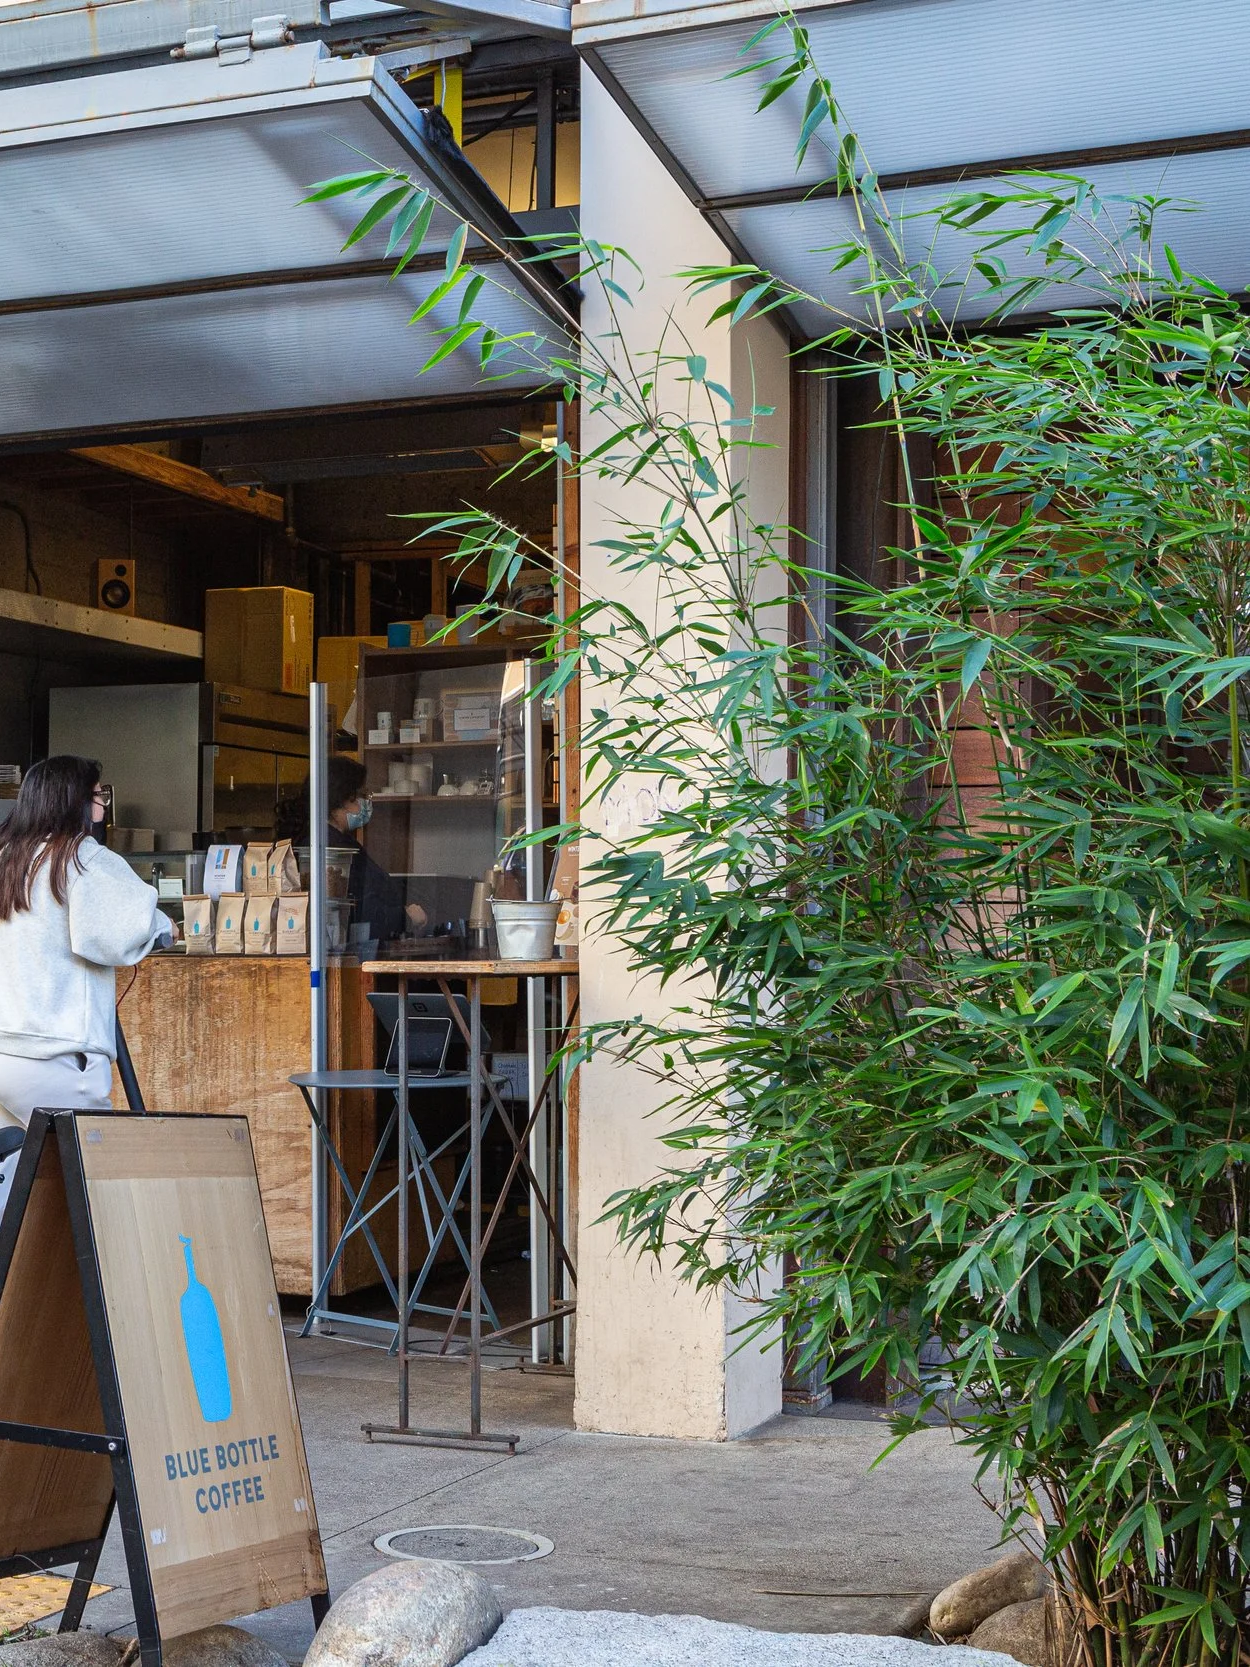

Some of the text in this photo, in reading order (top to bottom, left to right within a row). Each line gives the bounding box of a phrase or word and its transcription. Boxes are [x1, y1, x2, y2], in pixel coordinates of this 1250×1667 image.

[165, 1434, 280, 1481] BLUE BOTTLE
[195, 1476, 265, 1514] COFFEE
